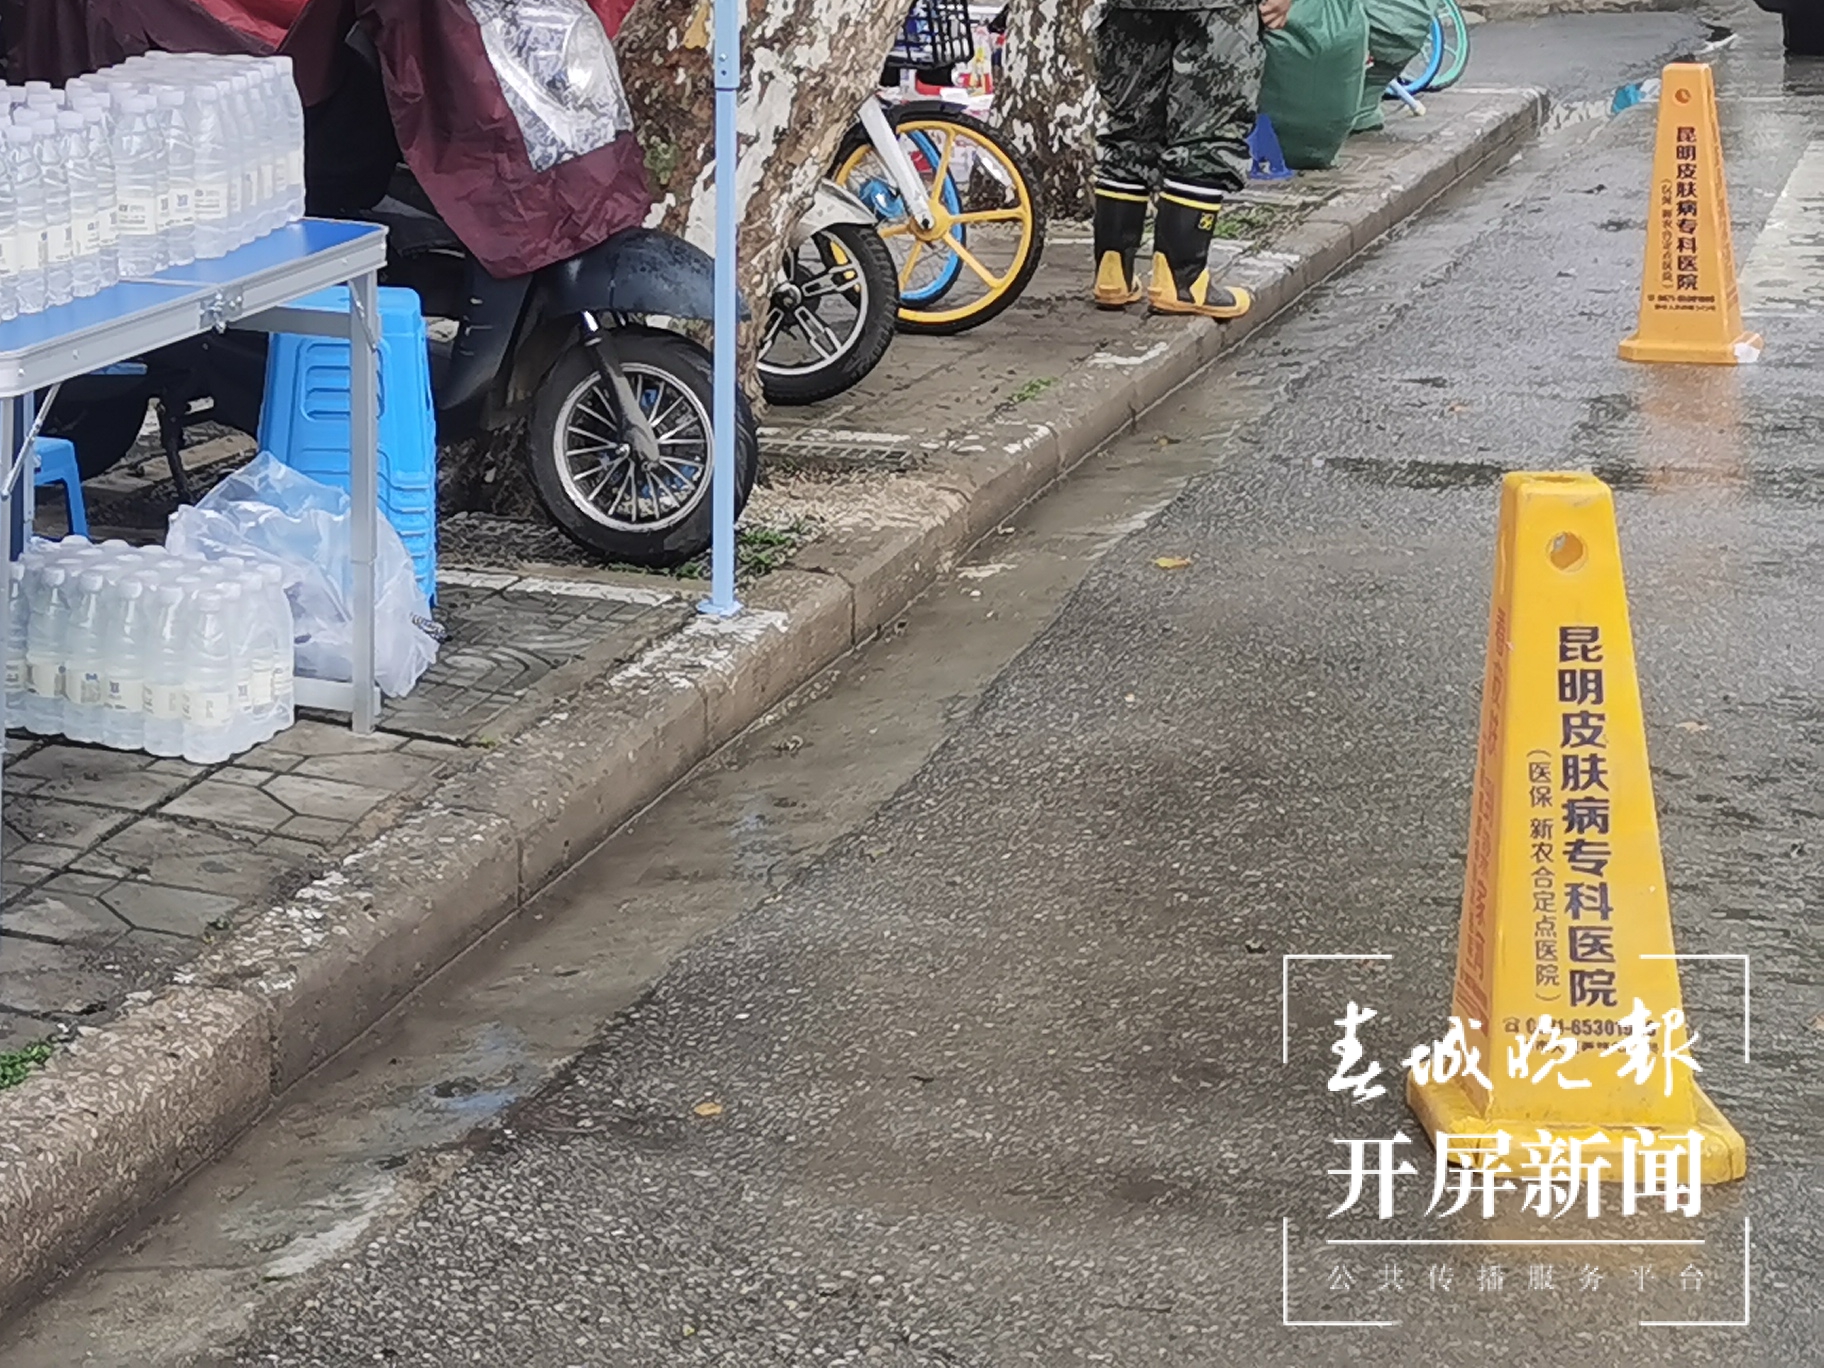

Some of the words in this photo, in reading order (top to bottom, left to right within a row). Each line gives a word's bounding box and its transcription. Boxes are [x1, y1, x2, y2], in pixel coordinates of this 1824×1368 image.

[1675, 126, 1698, 291] 昆明皮肤病专科医院
[1557, 625, 1619, 1008] 昆明皮肤病专科医院
